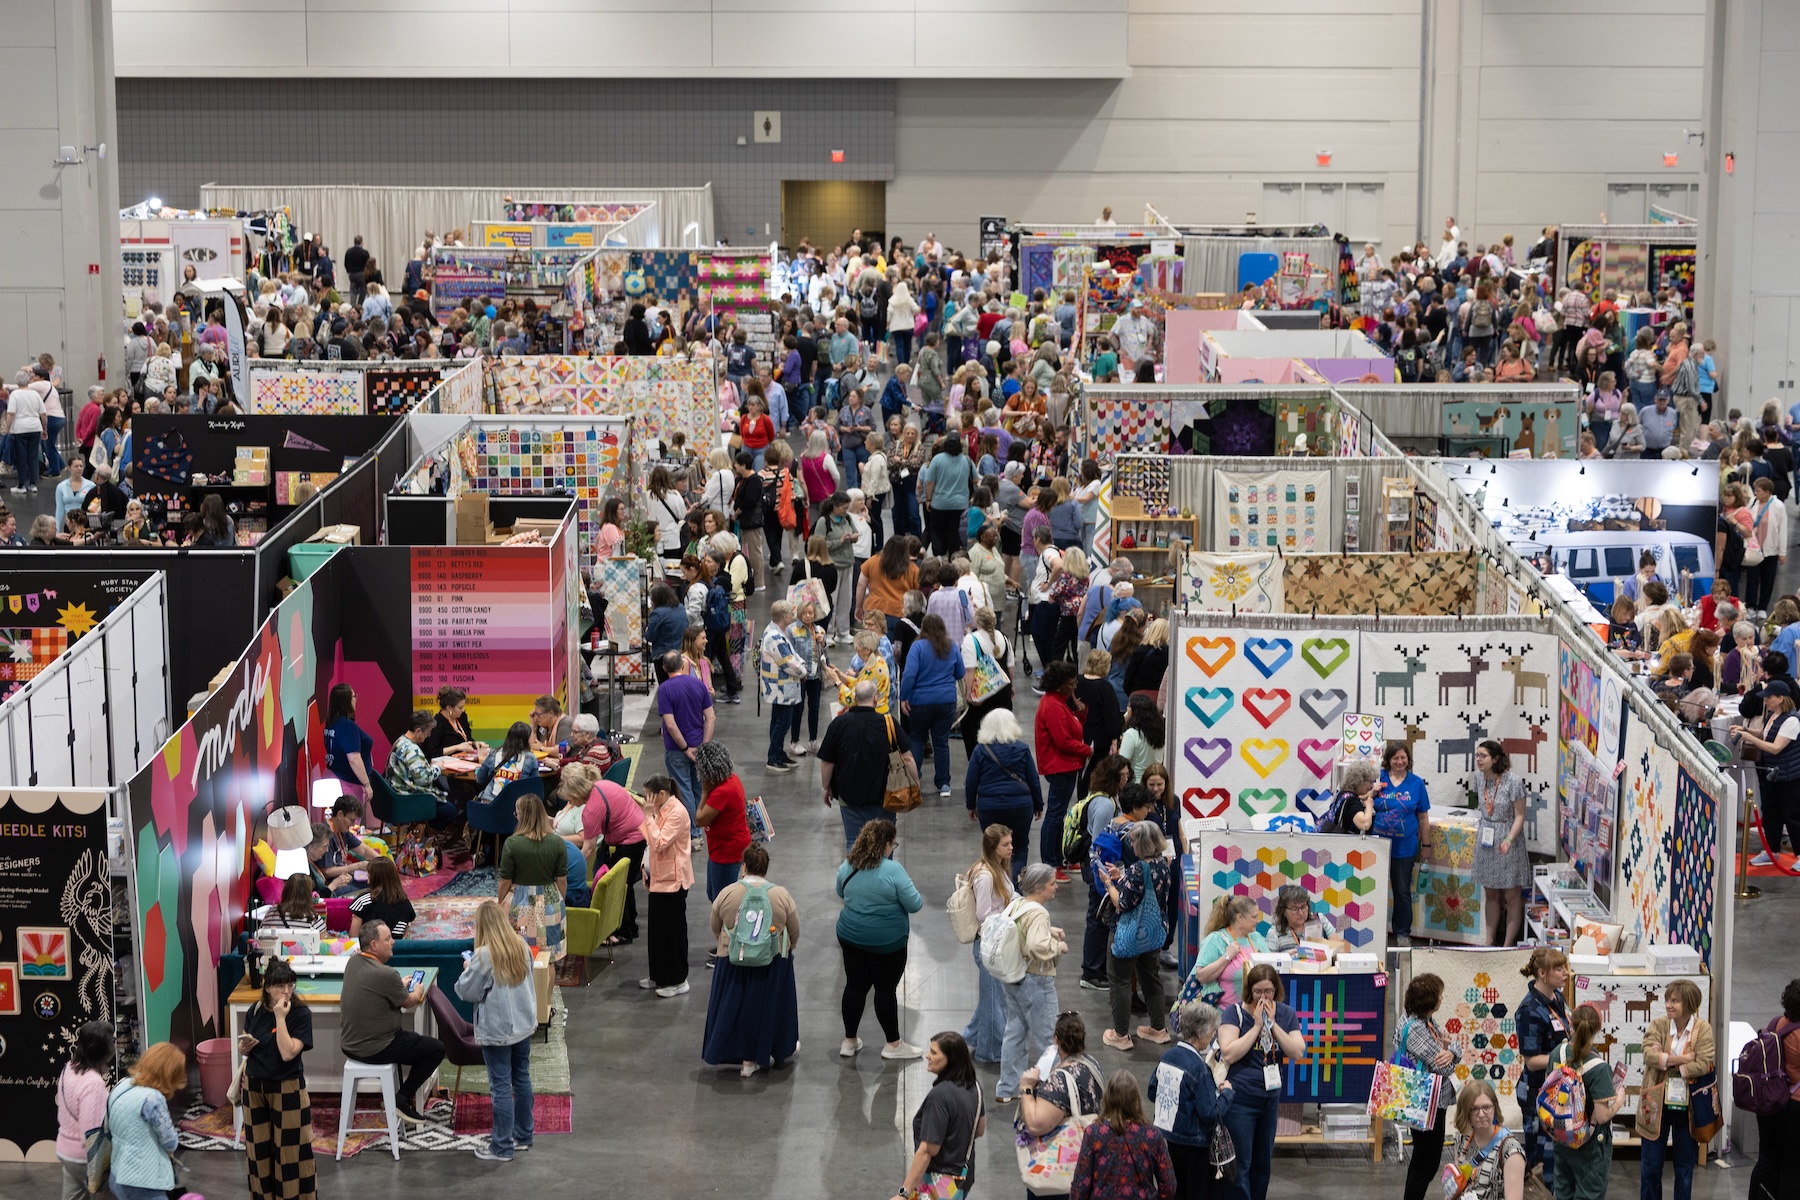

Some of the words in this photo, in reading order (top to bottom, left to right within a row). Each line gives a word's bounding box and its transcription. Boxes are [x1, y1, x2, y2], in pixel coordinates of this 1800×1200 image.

[13, 600, 18, 608] E
[30, 598, 37, 606] R
[191, 652, 272, 792] moda
[496, 769, 519, 780] HOPE
[53, 825, 86, 838] KITS!
[1375, 978, 1386, 987] KIT
[0, 1075, 14, 1084] ade
[26, 1076, 50, 1088] Crafty
